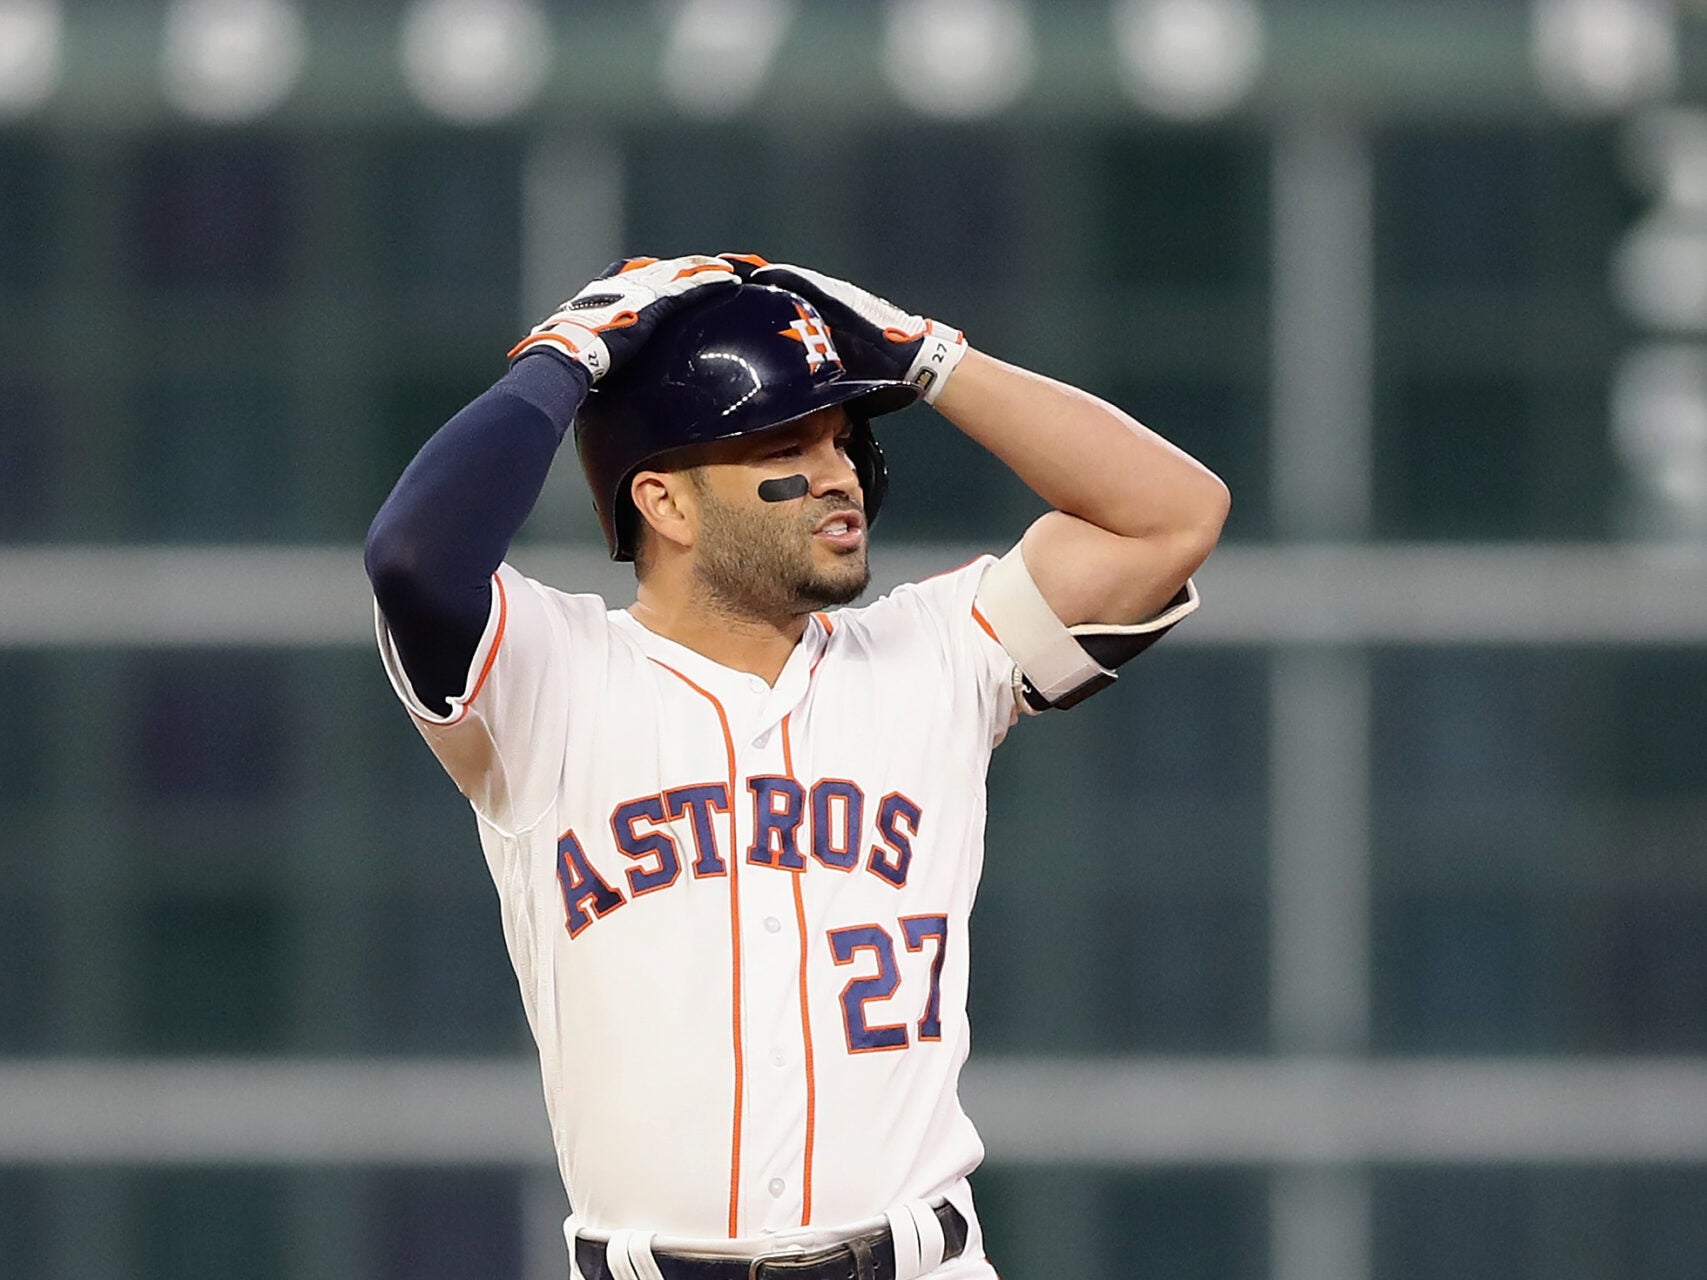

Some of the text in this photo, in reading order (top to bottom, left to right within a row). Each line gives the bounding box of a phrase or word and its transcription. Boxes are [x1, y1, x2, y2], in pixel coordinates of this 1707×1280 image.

[588, 351, 599, 367] 27
[932, 343, 947, 363] 27
[557, 774, 923, 940] ASTROS
[826, 913, 948, 1054] 27
